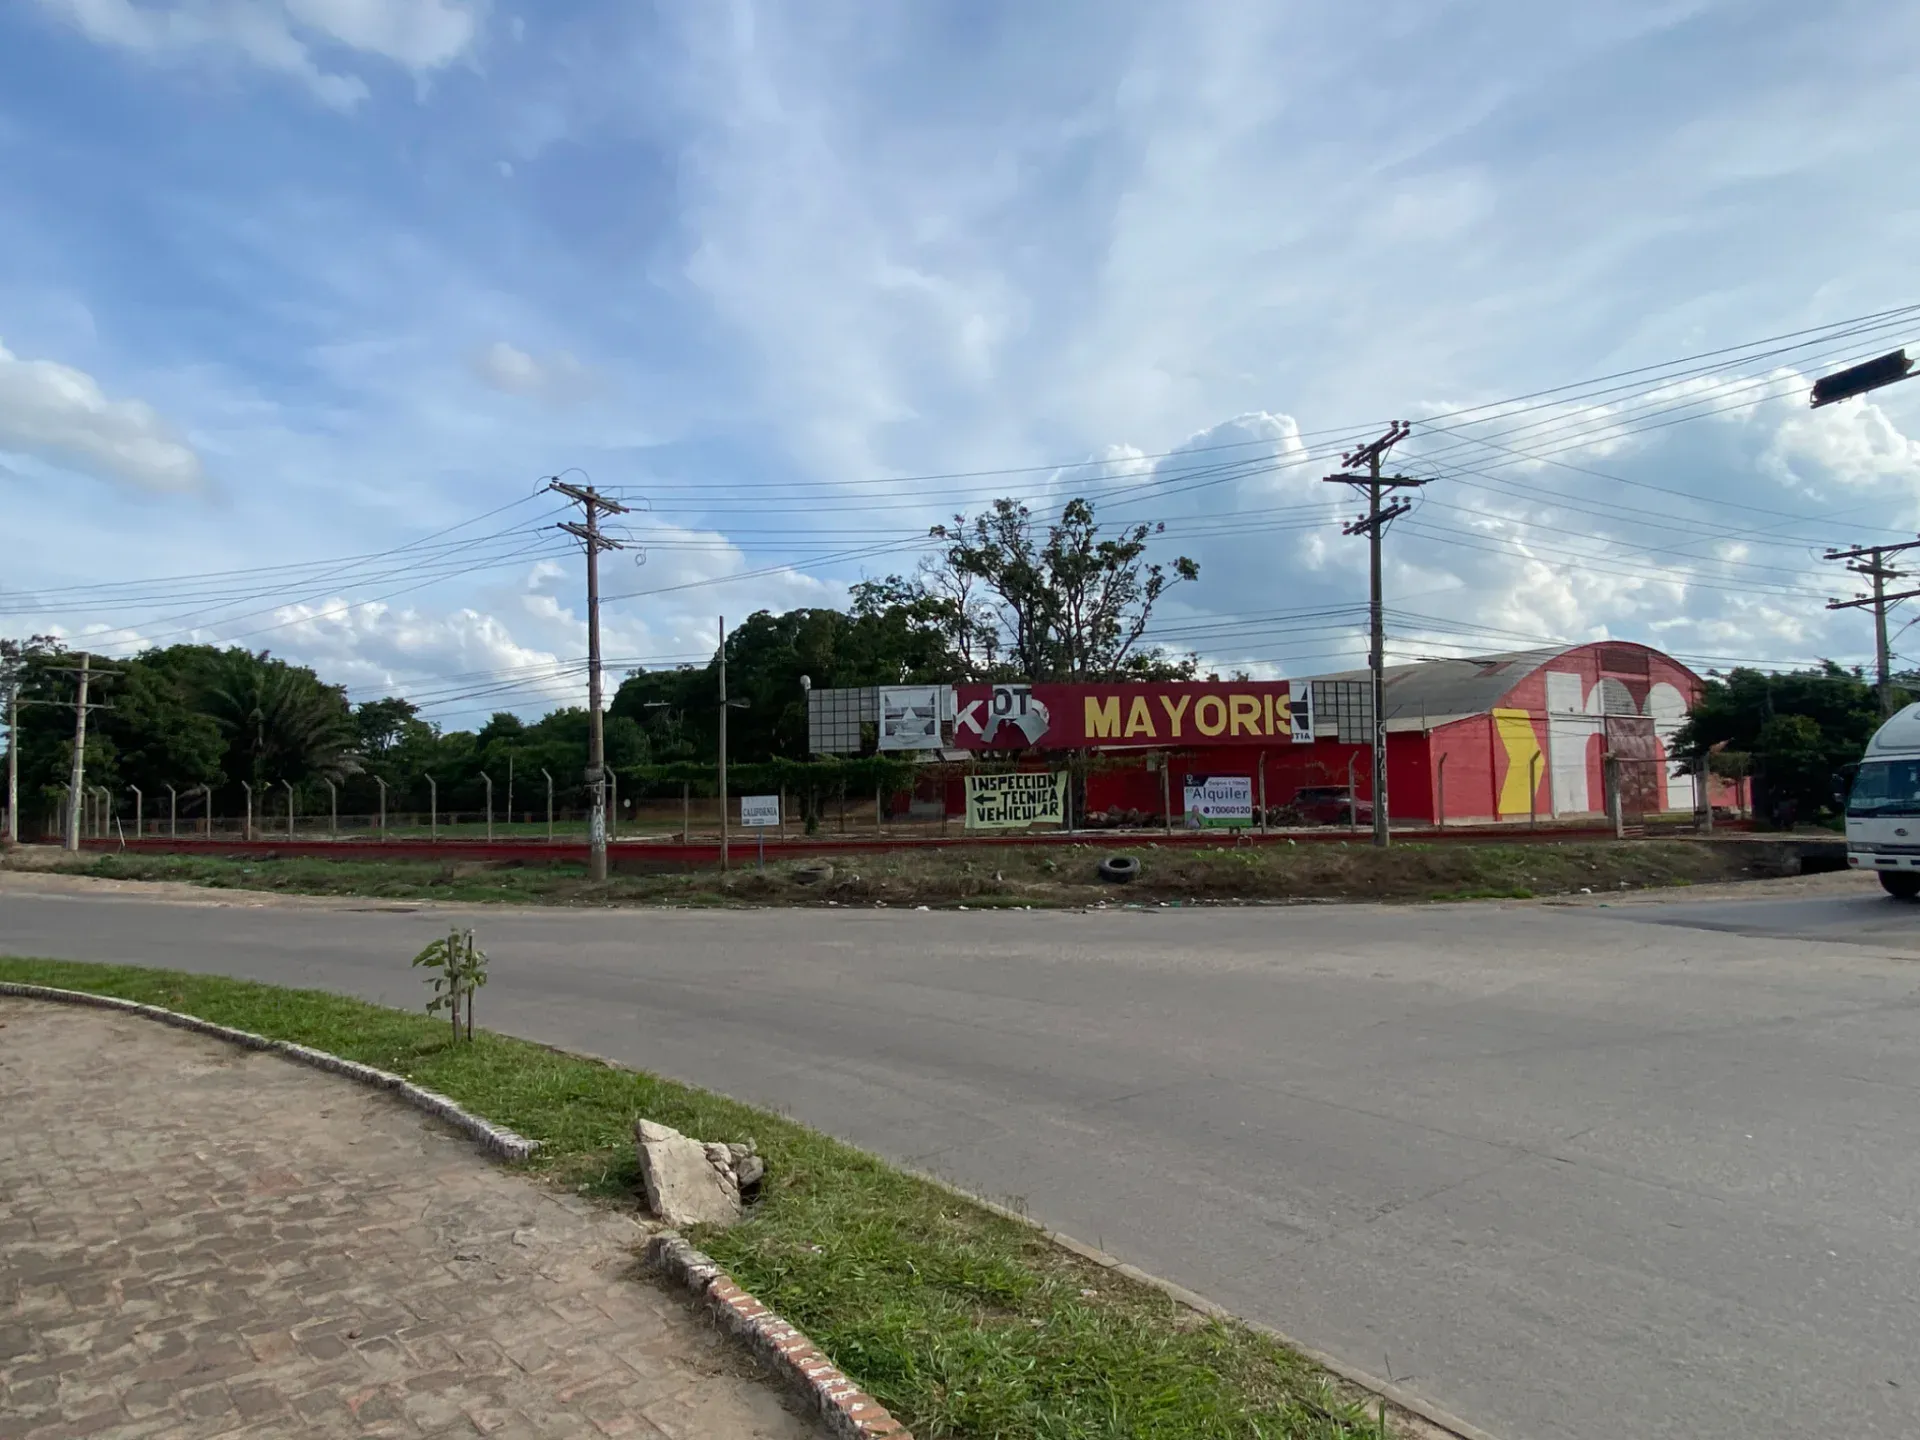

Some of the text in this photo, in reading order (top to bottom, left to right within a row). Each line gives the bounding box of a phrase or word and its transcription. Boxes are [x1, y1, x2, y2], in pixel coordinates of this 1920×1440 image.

[971, 772, 1058, 791] INSPECCION
[1001, 788, 1058, 806] TECNICA
[1193, 787, 1248, 802] Alquiler
[743, 807, 778, 817] CALIFORNIA
[977, 802, 1059, 821] VEHICULAR
